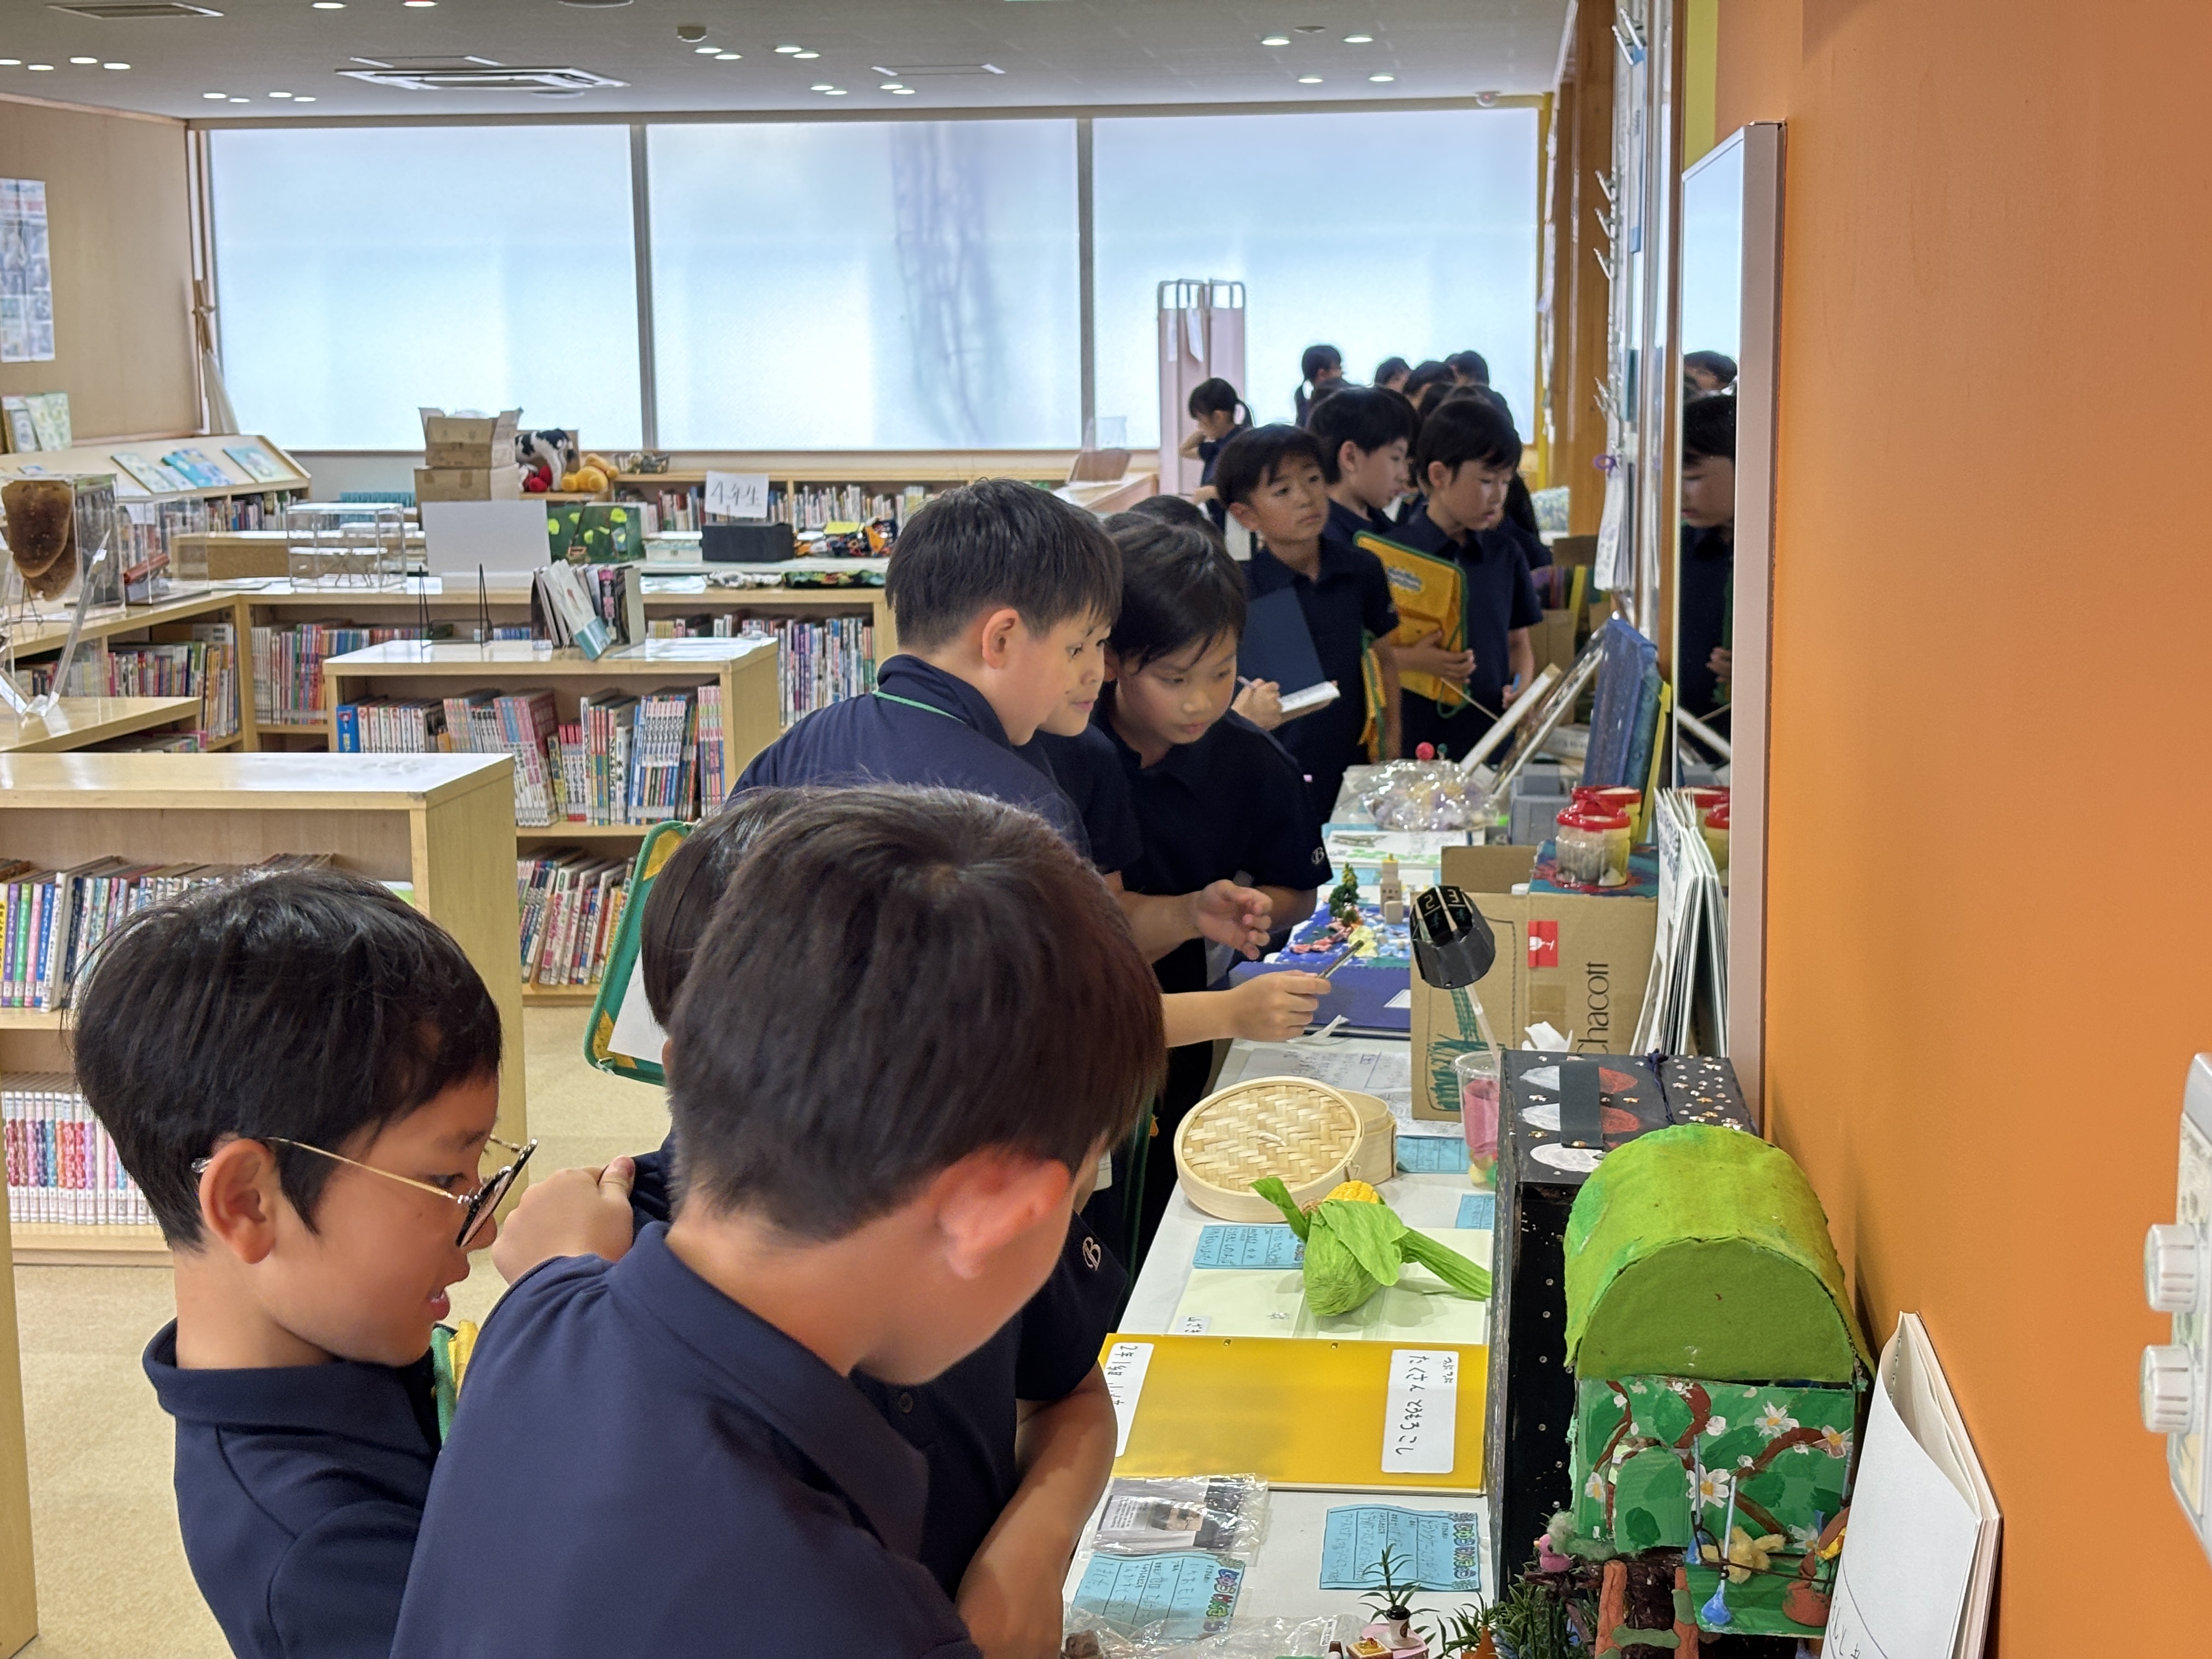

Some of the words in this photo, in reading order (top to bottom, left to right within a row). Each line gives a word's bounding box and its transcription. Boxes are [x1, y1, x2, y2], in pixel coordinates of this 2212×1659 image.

[1405, 1355, 1430, 1392] たくさん
[1395, 1399, 1423, 1455] とうもろこし
